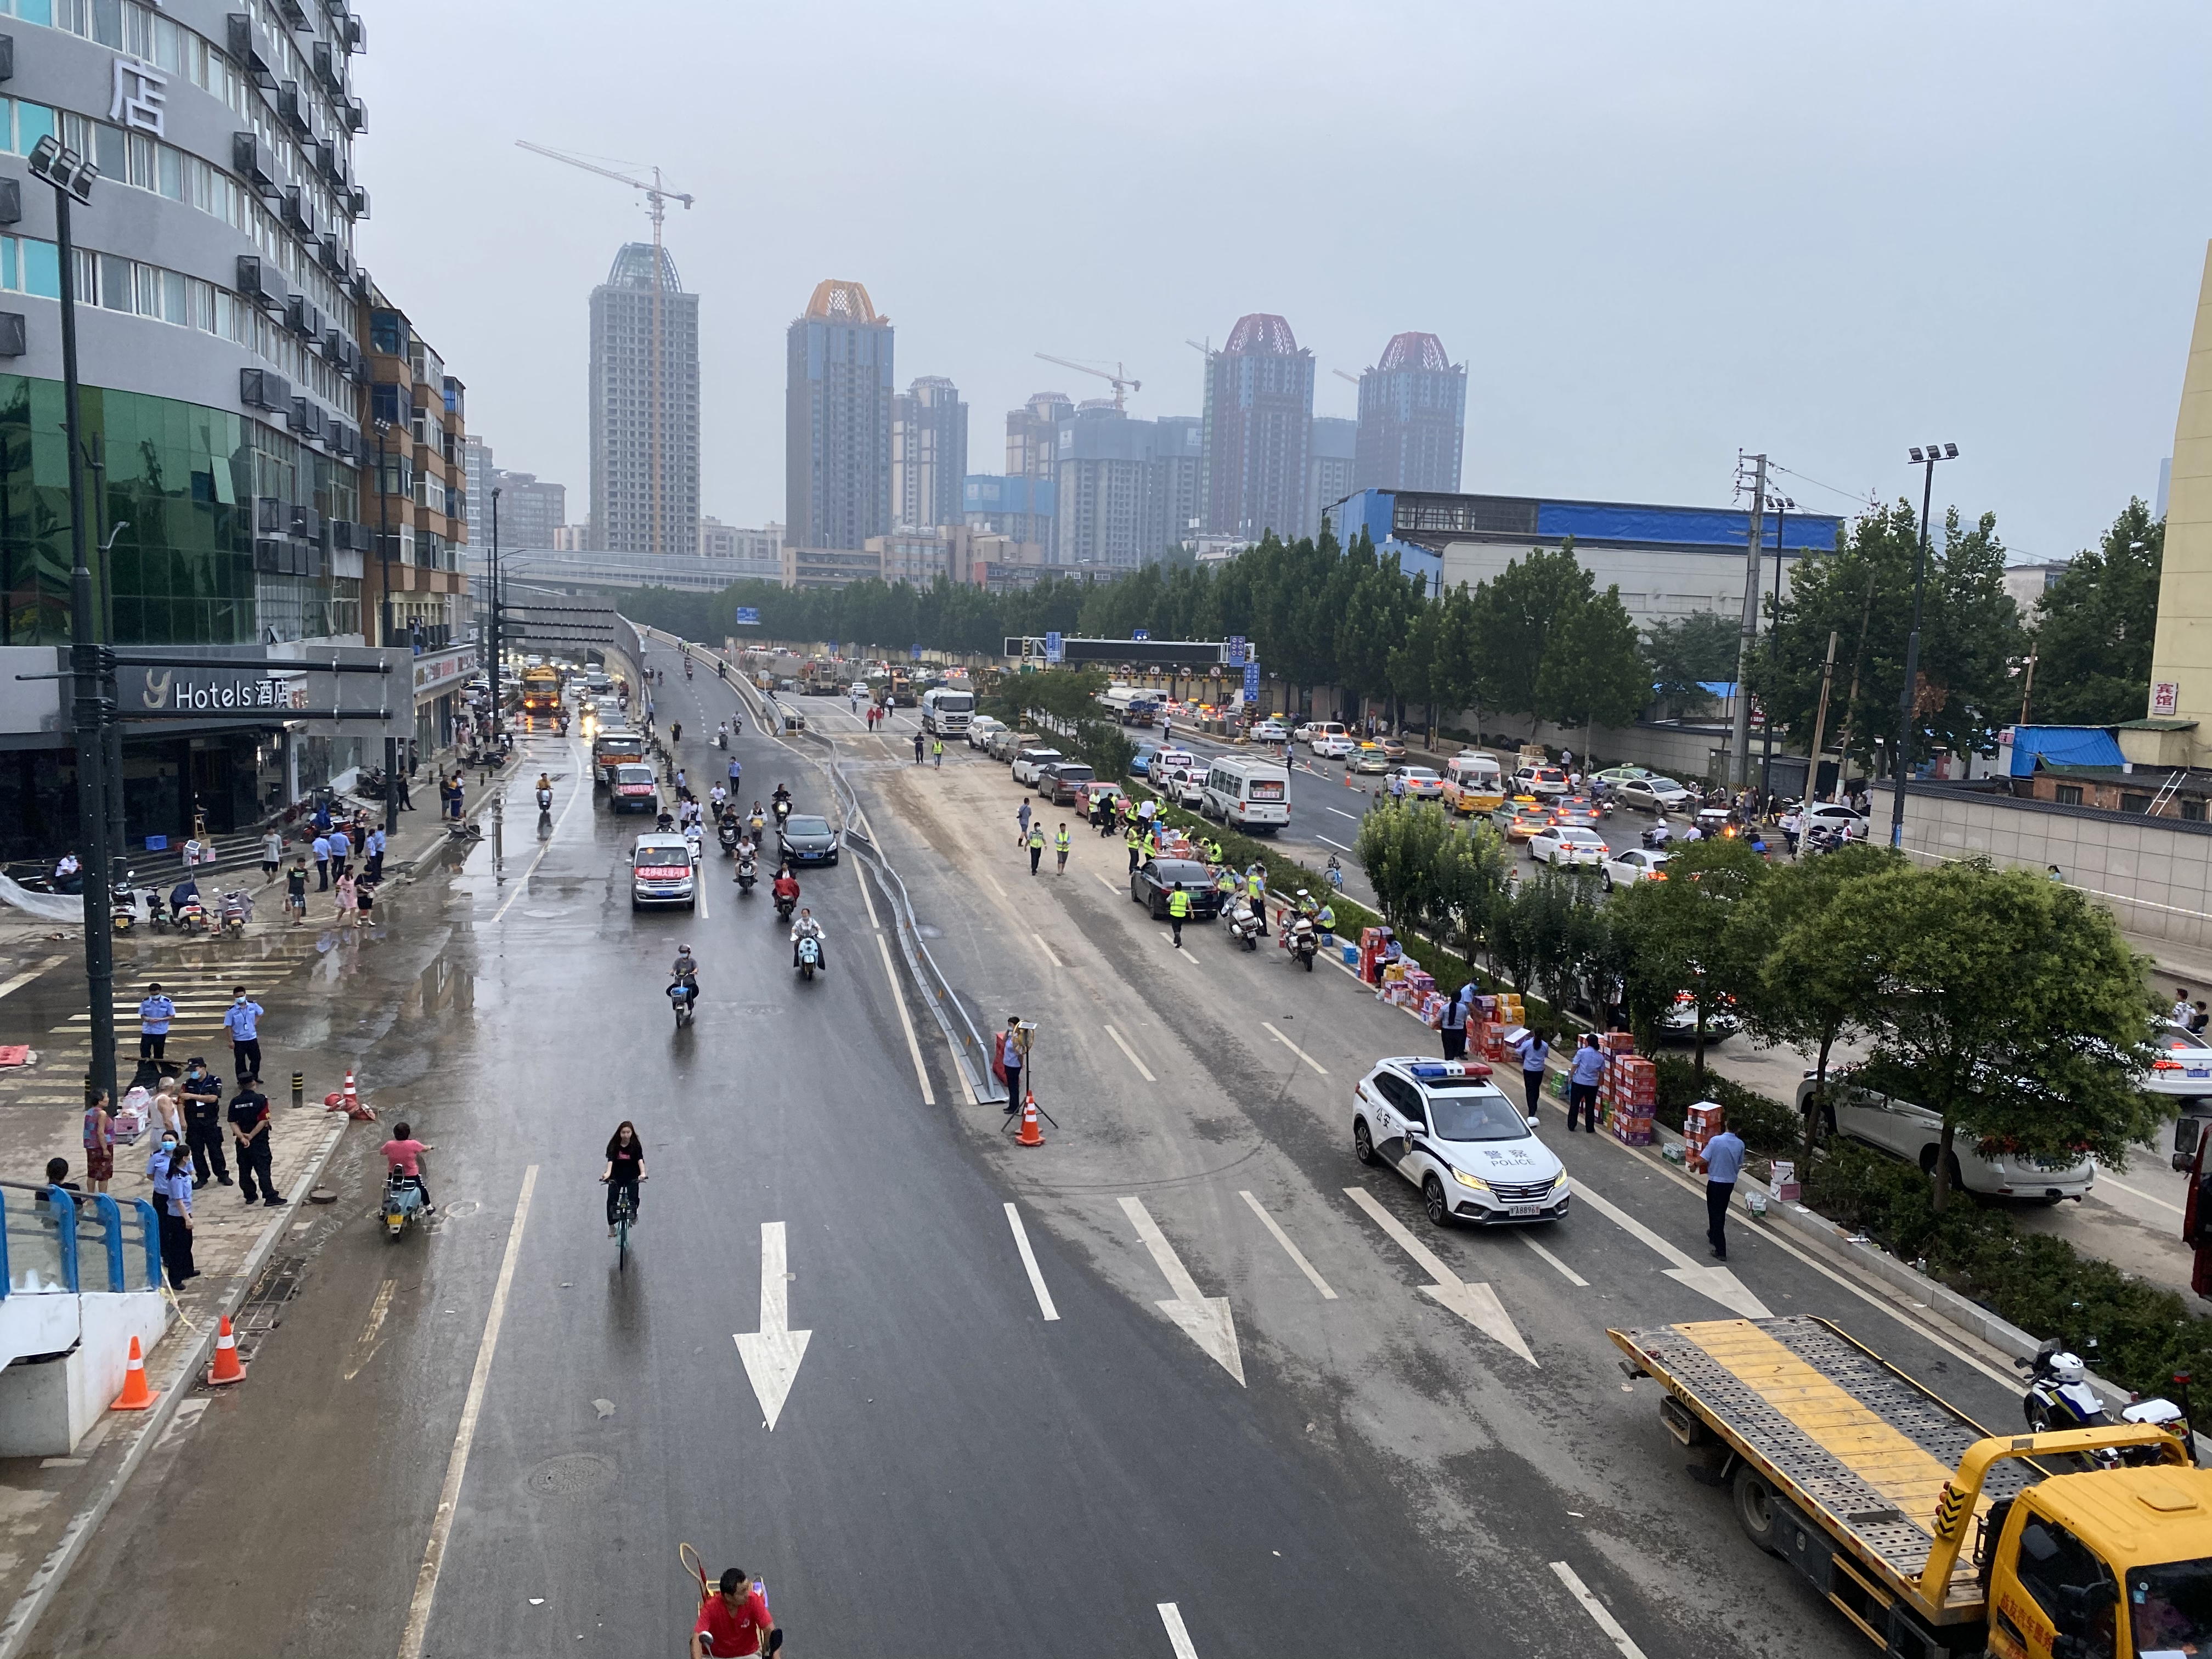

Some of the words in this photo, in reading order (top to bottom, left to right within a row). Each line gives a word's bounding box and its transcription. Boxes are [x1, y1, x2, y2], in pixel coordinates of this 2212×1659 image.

[109, 59, 167, 138] 店
[176, 680, 251, 708] Hotels
[255, 678, 290, 706] 酒店
[2156, 684, 2174, 706] 宾馆
[1376, 1107, 1391, 1130] 公安
[1482, 1149, 1529, 1159] 警察
[1491, 1159, 1536, 1167] POLICE
[2000, 1592, 2052, 1652] 战友汽车服务
